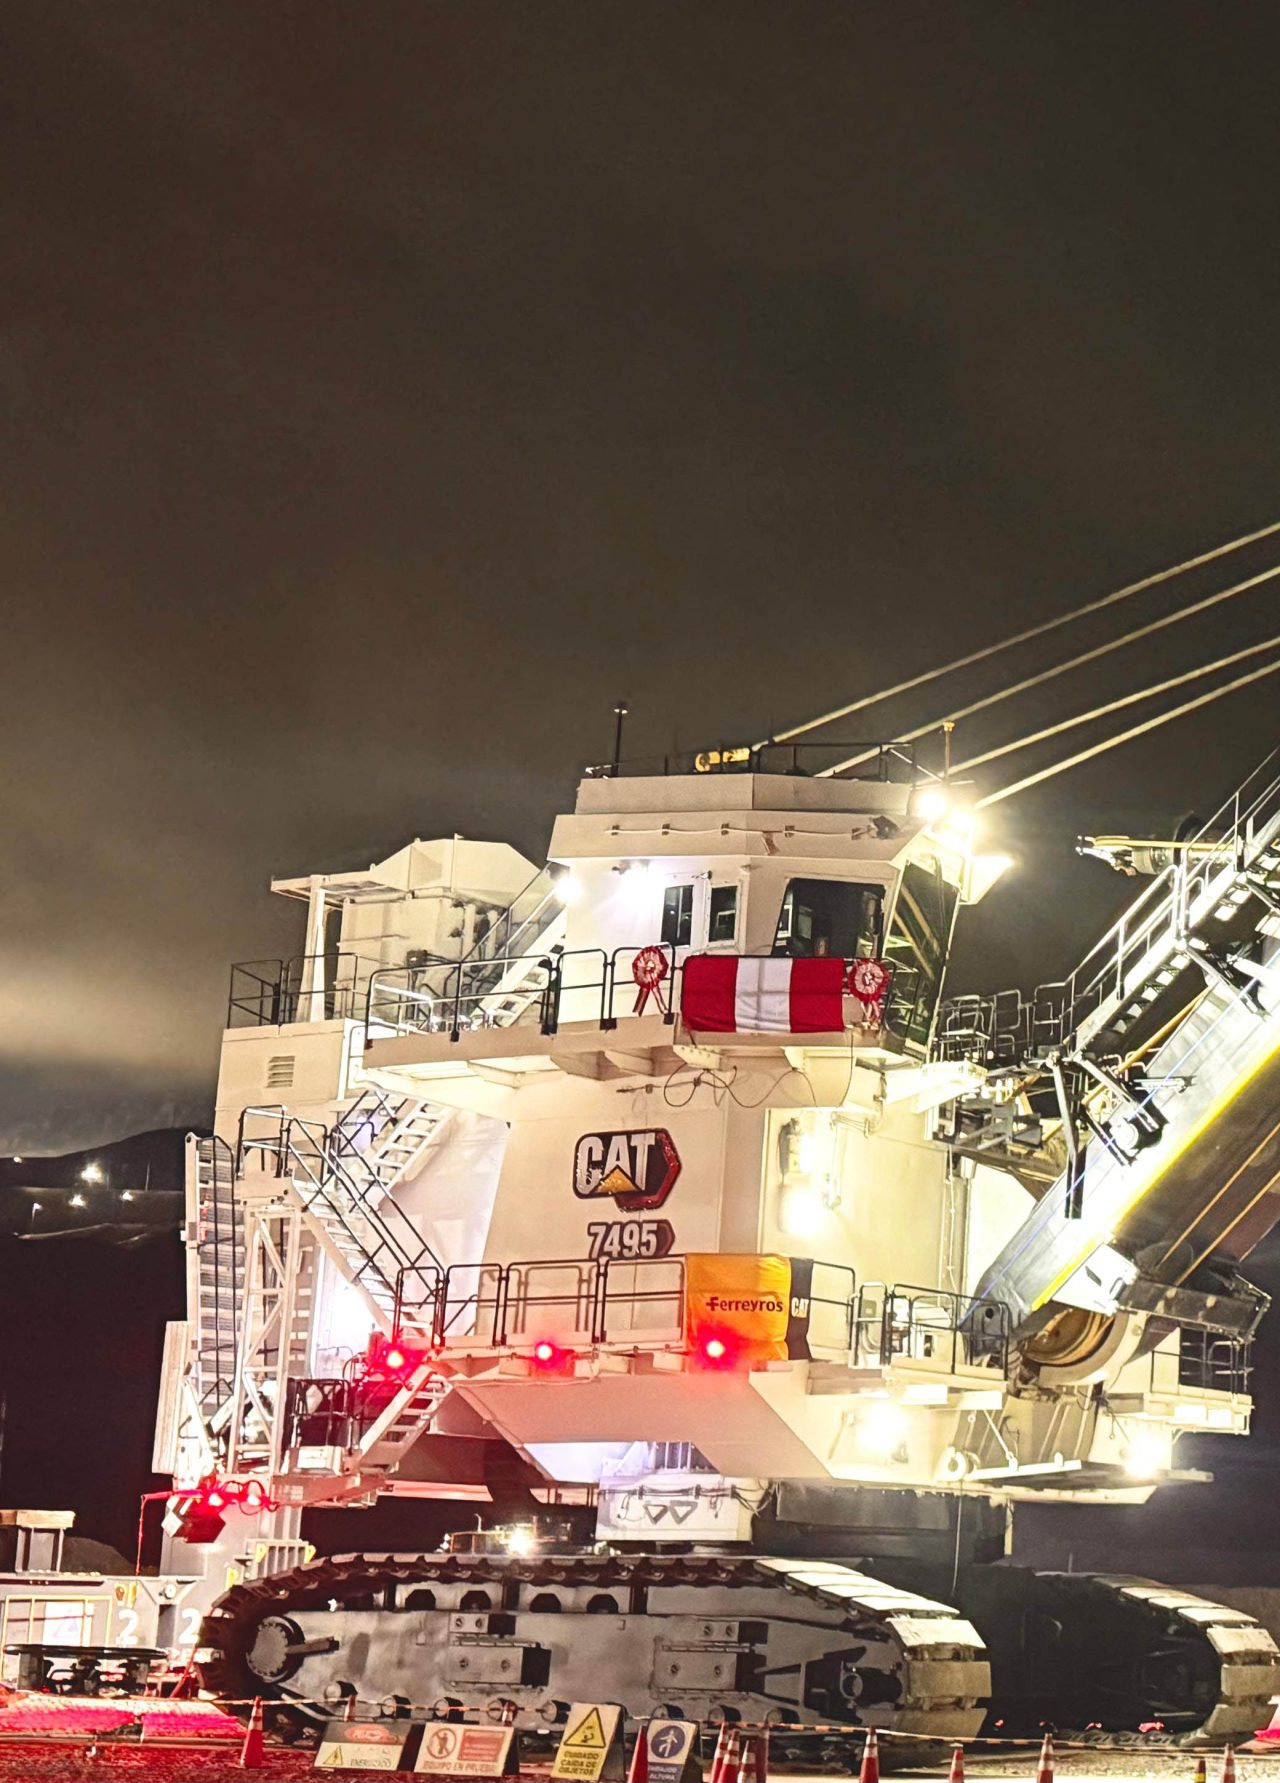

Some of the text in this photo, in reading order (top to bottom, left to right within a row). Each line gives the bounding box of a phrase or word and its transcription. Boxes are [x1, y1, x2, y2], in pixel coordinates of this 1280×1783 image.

[575, 1132, 656, 1195] CAT
[589, 1223, 658, 1258] 7495
[706, 1296, 783, 1314] Ferreyros
[791, 1297, 809, 1318] CAT
